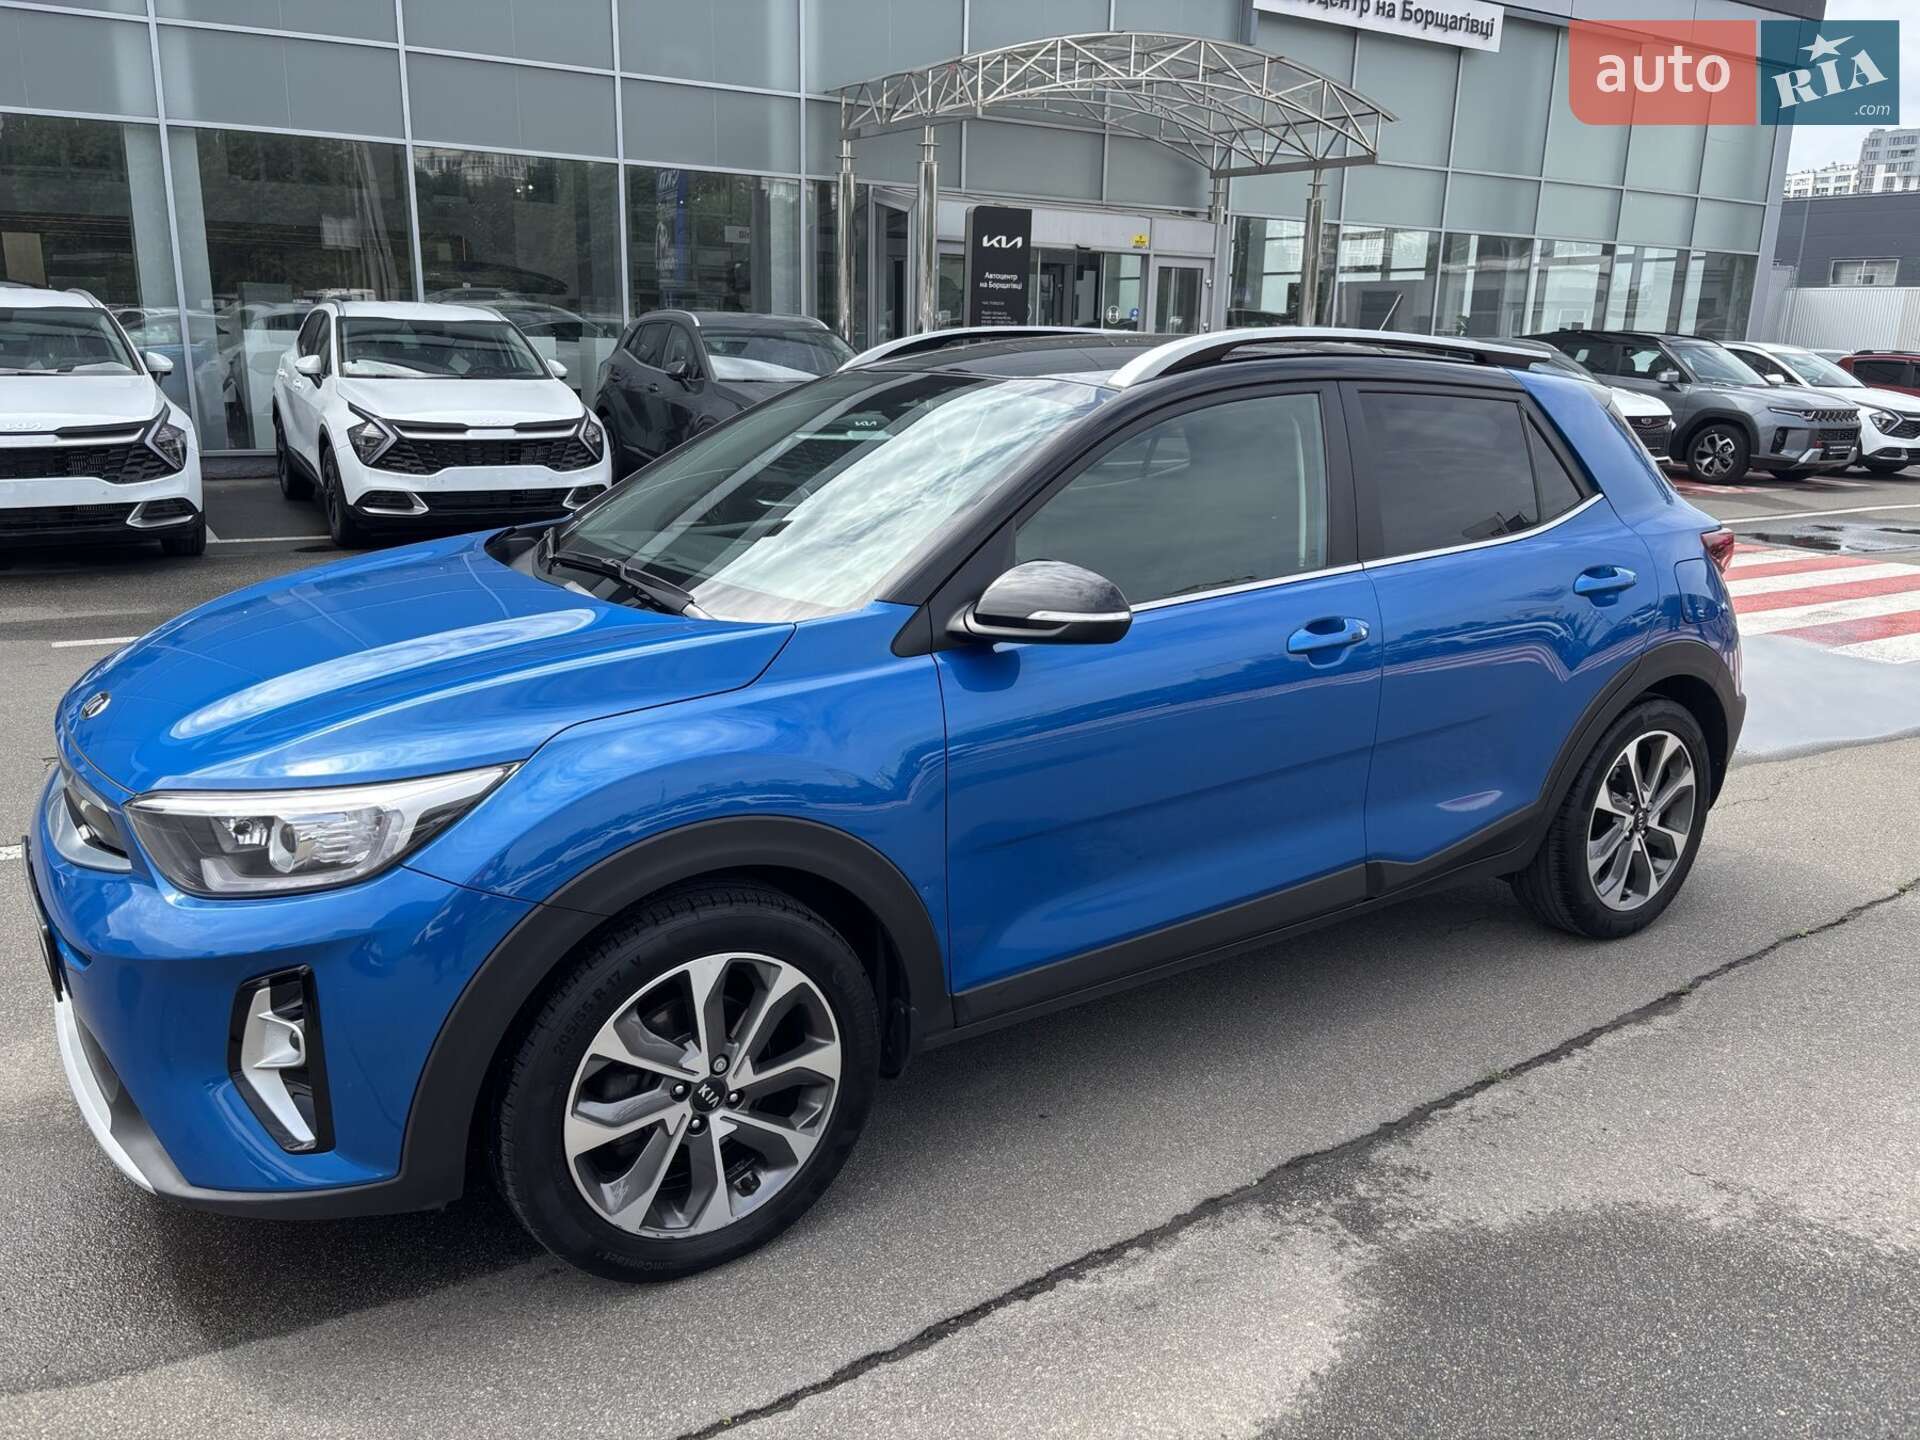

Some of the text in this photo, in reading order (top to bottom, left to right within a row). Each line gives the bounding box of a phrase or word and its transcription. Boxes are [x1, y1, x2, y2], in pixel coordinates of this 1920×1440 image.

[1303, 0, 1495, 39] центр на Борщагівці
[982, 235, 1023, 249] KIA
[984, 272, 1018, 281] Автоцентр
[698, 1083, 720, 1108] KIA
